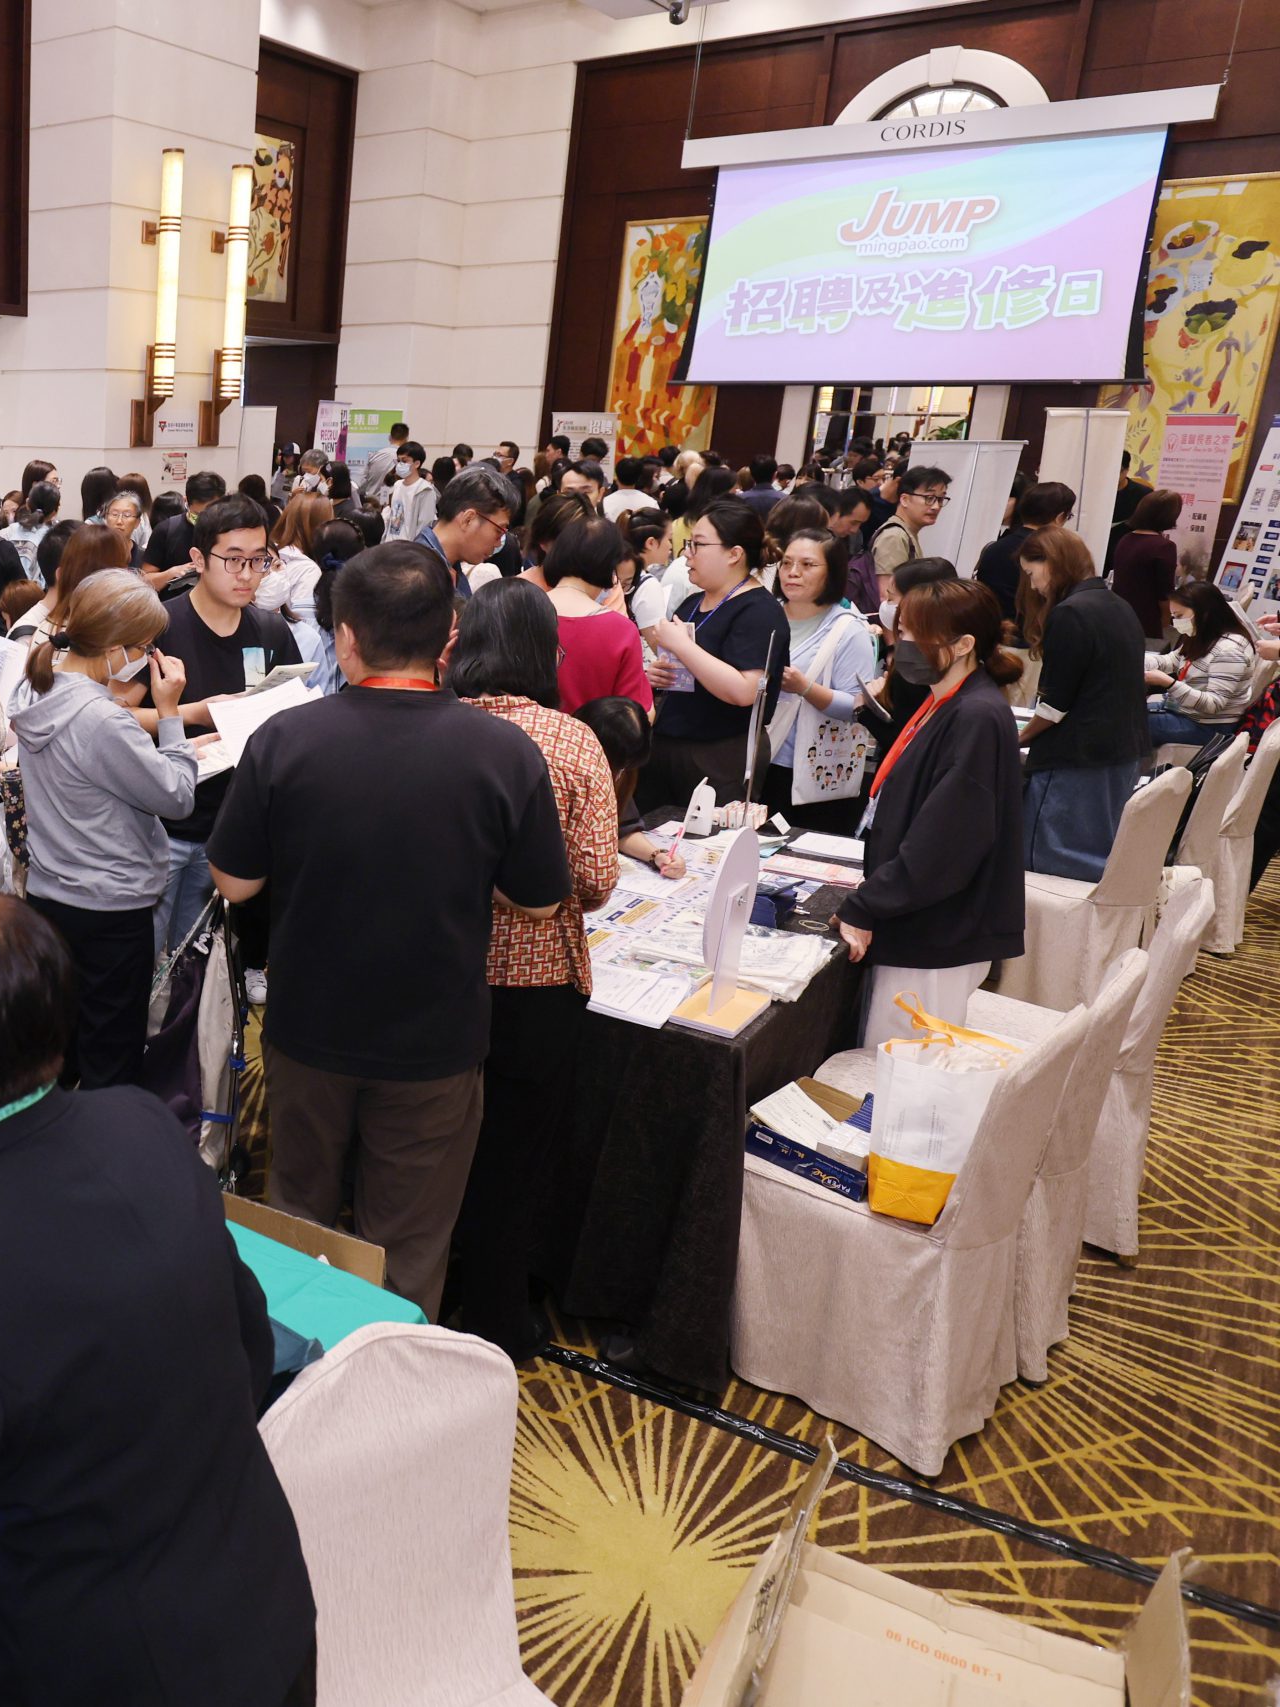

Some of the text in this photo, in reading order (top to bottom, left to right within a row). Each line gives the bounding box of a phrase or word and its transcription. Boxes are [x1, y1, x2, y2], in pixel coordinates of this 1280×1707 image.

[880, 120, 966, 143] CORDIS
[839, 188, 998, 243] JUMP
[858, 236, 965, 256] mingpao.com
[725, 268, 1100, 334] 招聘及進修日
[588, 420, 613, 435] 招聘
[826, 1178, 851, 1194] PAPER
